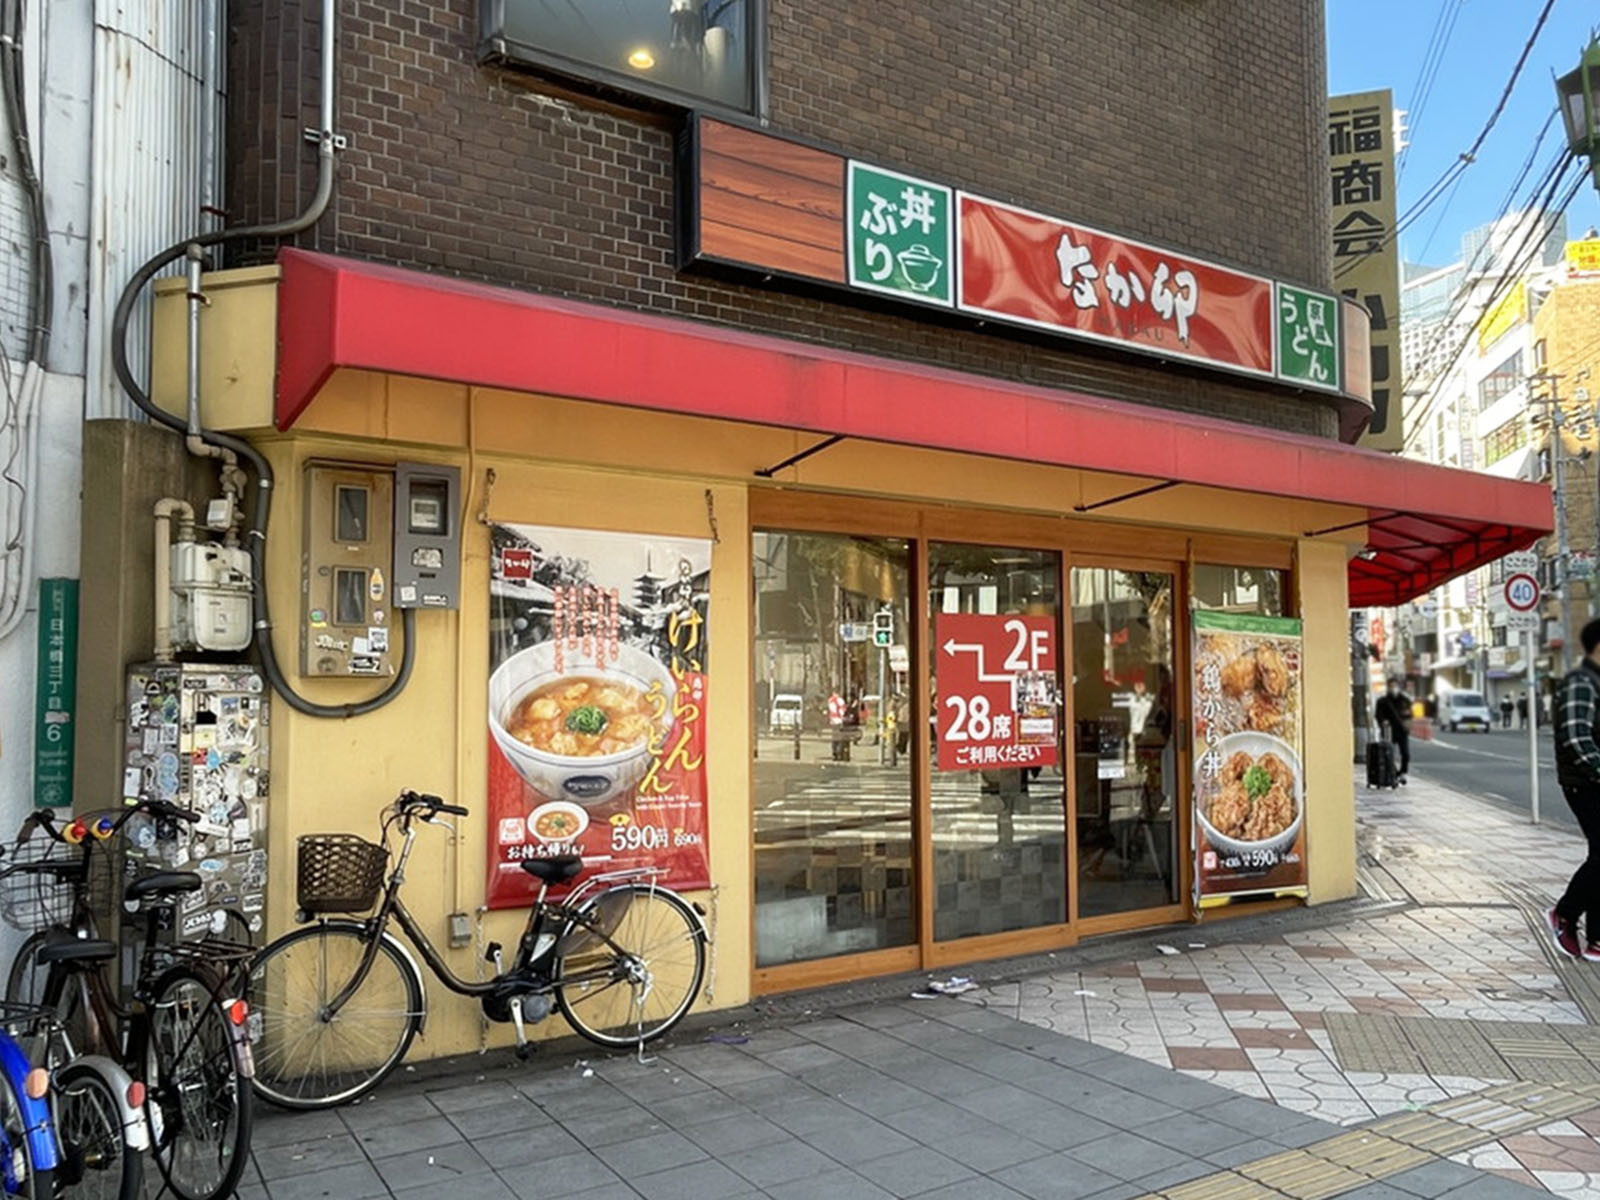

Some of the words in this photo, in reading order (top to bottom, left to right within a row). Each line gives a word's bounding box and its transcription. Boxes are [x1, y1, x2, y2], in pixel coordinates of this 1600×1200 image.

[1329, 105, 1386, 257] 福商会
[1056, 233, 1198, 349] なか卯
[1281, 292, 1328, 381] うどん
[1512, 583, 1532, 601] 40
[1003, 619, 1049, 671] 2F
[46, 723, 62, 743] 6
[639, 681, 673, 793] うどん
[955, 744, 1041, 764] ご利用ください
[611, 824, 669, 851] 590円
